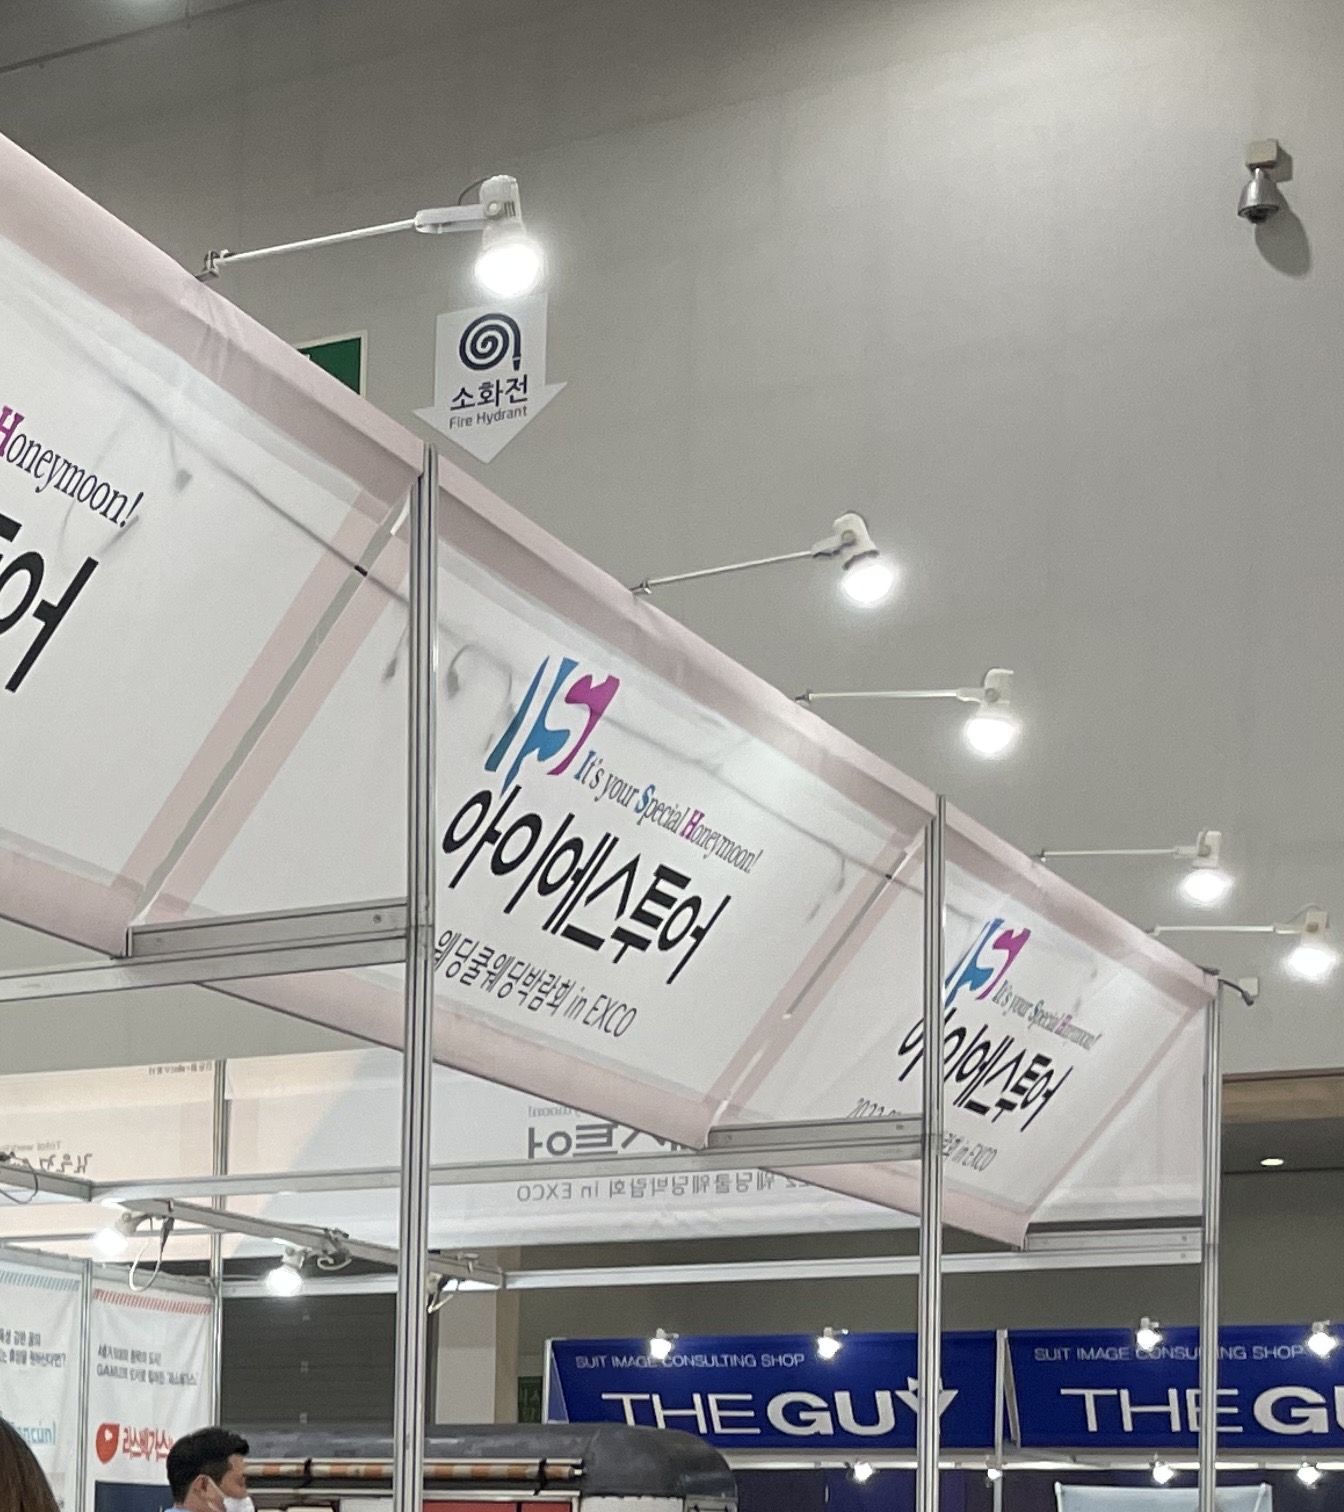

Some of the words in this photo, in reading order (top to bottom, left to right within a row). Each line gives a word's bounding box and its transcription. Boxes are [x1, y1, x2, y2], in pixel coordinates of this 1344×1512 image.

[450, 374, 529, 412] 소화전
[449, 408, 473, 430] Fire
[476, 404, 528, 427] Hydrant
[573, 750, 605, 790] It's
[594, 773, 640, 808] your
[633, 784, 691, 826] Special
[679, 809, 764, 875] Honeymoon!
[442, 784, 731, 985] 아이에스투어
[563, 986, 588, 1020] in
[582, 993, 638, 1038] EXCO
[898, 1007, 1074, 1132] 아이에스투어
[575, 1354, 608, 1369] SUIT
[611, 1354, 658, 1369] IMAGE
[661, 1353, 757, 1369] CONSULTING
[761, 1353, 805, 1367] SHOP
[1034, 1347, 1070, 1361] SUIT
[1076, 1347, 1133, 1361] IMAGE
[1253, 1345, 1307, 1359] SHOP
[1060, 1388, 1243, 1433] THE
